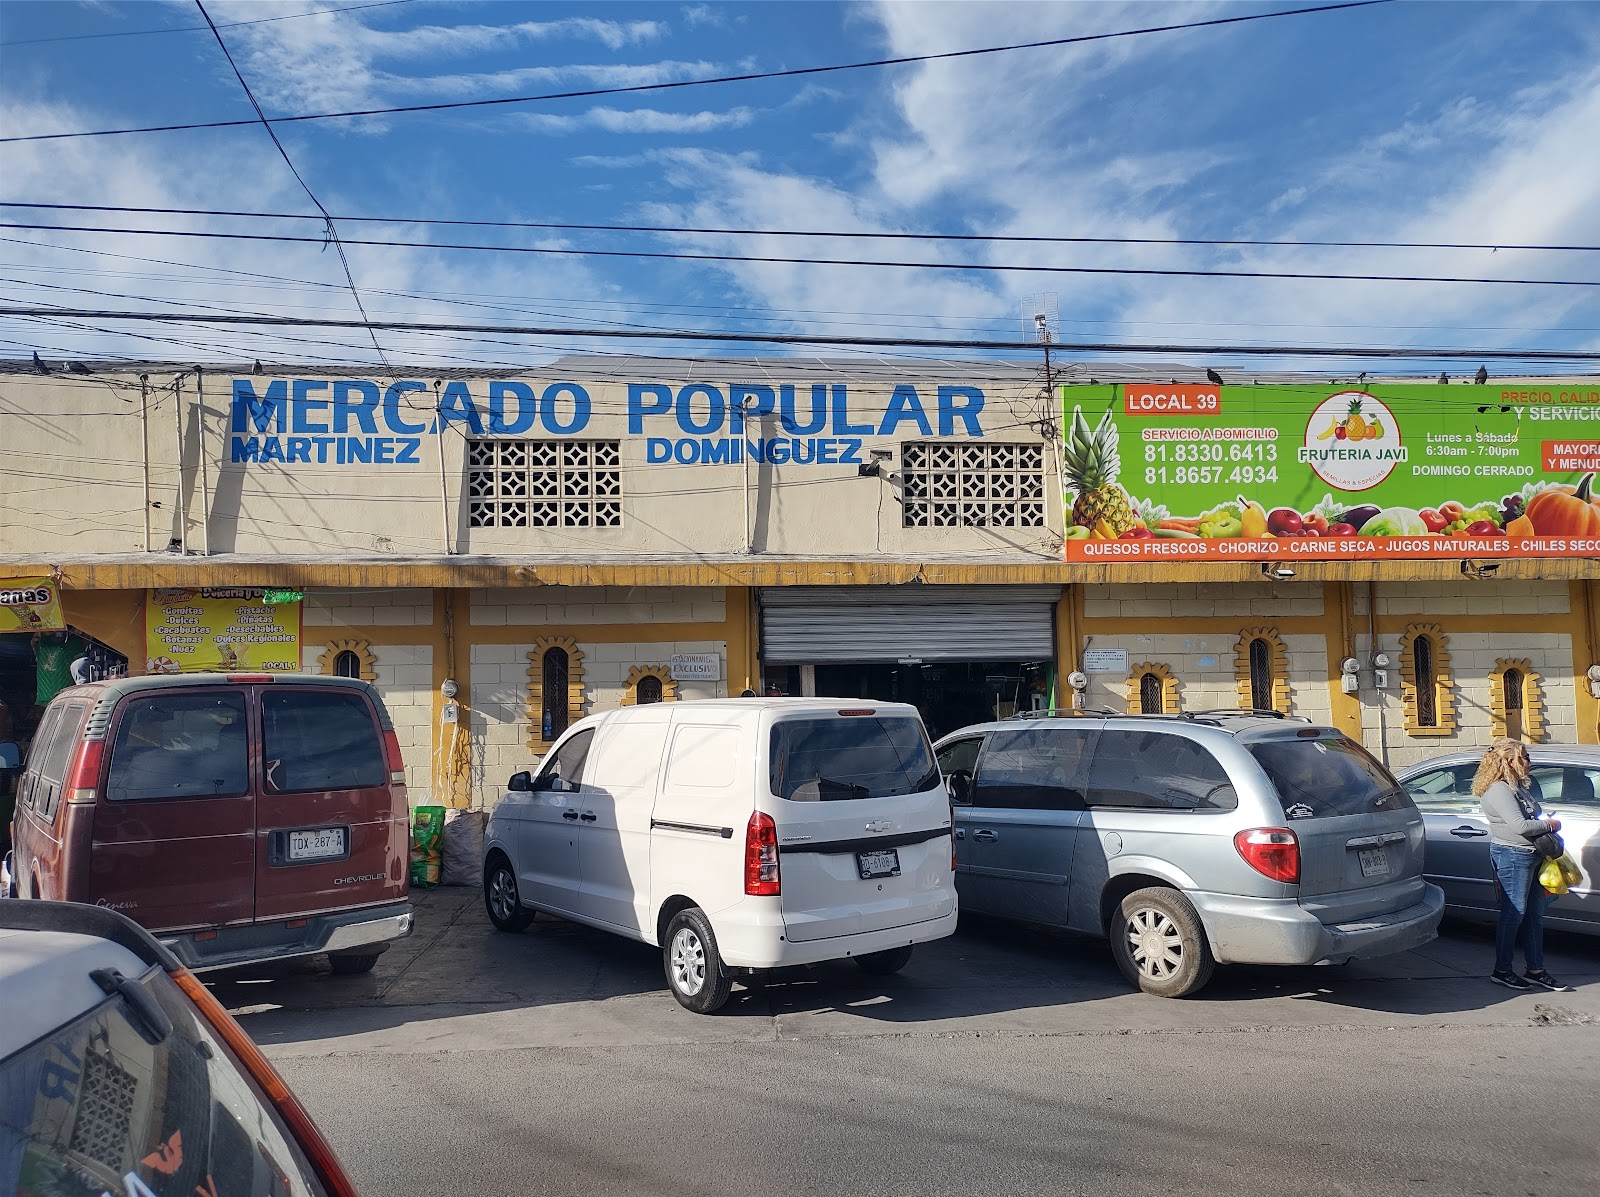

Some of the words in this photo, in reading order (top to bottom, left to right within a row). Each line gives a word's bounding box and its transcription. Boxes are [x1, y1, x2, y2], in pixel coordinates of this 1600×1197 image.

[1129, 394, 1192, 410] LOCAL
[1197, 394, 1217, 410] 39
[1501, 391, 1555, 404] PRECIO,
[232, 379, 591, 435] MERCADO
[627, 383, 986, 437] POPULAR
[1514, 406, 1525, 420] Y
[1143, 430, 1200, 440] SERVICIO
[1203, 430, 1212, 439] A
[1215, 429, 1277, 439] DOMICILIO
[1427, 432, 1462, 443] Lunes
[1465, 434, 1472, 443] a
[1475, 432, 1518, 443] Sábado
[231, 436, 420, 464] MARTINEZ
[646, 437, 863, 465] DOMINGUEZ
[1145, 444, 1278, 462] 81.8330.6413
[1300, 449, 1371, 460] FRUTERIA
[1376, 449, 1406, 460] JAVI
[1426, 446, 1467, 456] 6:30am
[1478, 446, 1520, 458] 7:00pm
[1548, 459, 1557, 469] Y
[1145, 465, 1278, 484] 81.8657.4934
[1412, 465, 1471, 476] DOMINGO
[1474, 465, 1534, 476] CERRADO
[1322, 470, 1351, 486] SEMILLAS
[1358, 469, 1386, 485] ESPECIAS
[1083, 543, 1140, 555] QUESOS
[1144, 543, 1207, 555] FRESCOS
[1219, 542, 1279, 554] CHORIZO
[1290, 541, 1336, 553] CARNE
[1340, 541, 1375, 552] SECA
[1386, 540, 1430, 552] JUGOS
[1434, 540, 1510, 551] NATURALES
[1521, 540, 1566, 551] CHILES
[164, 606, 204, 615] Gomitas
[238, 606, 276, 614] Pistache
[169, 616, 199, 624] Dulces
[158, 626, 211, 634] Cacahuates
[229, 625, 284, 633] Desechables
[165, 635, 203, 643] Botanas
[217, 634, 246, 643] Dulces
[247, 634, 296, 644] Regionales
[172, 645, 195, 653] Nuez
[262, 661, 290, 670] LOCAL
[291, 661, 297, 670] 1
[334, 872, 388, 885] CHEVROLET
[95, 898, 139, 910] Geneva
